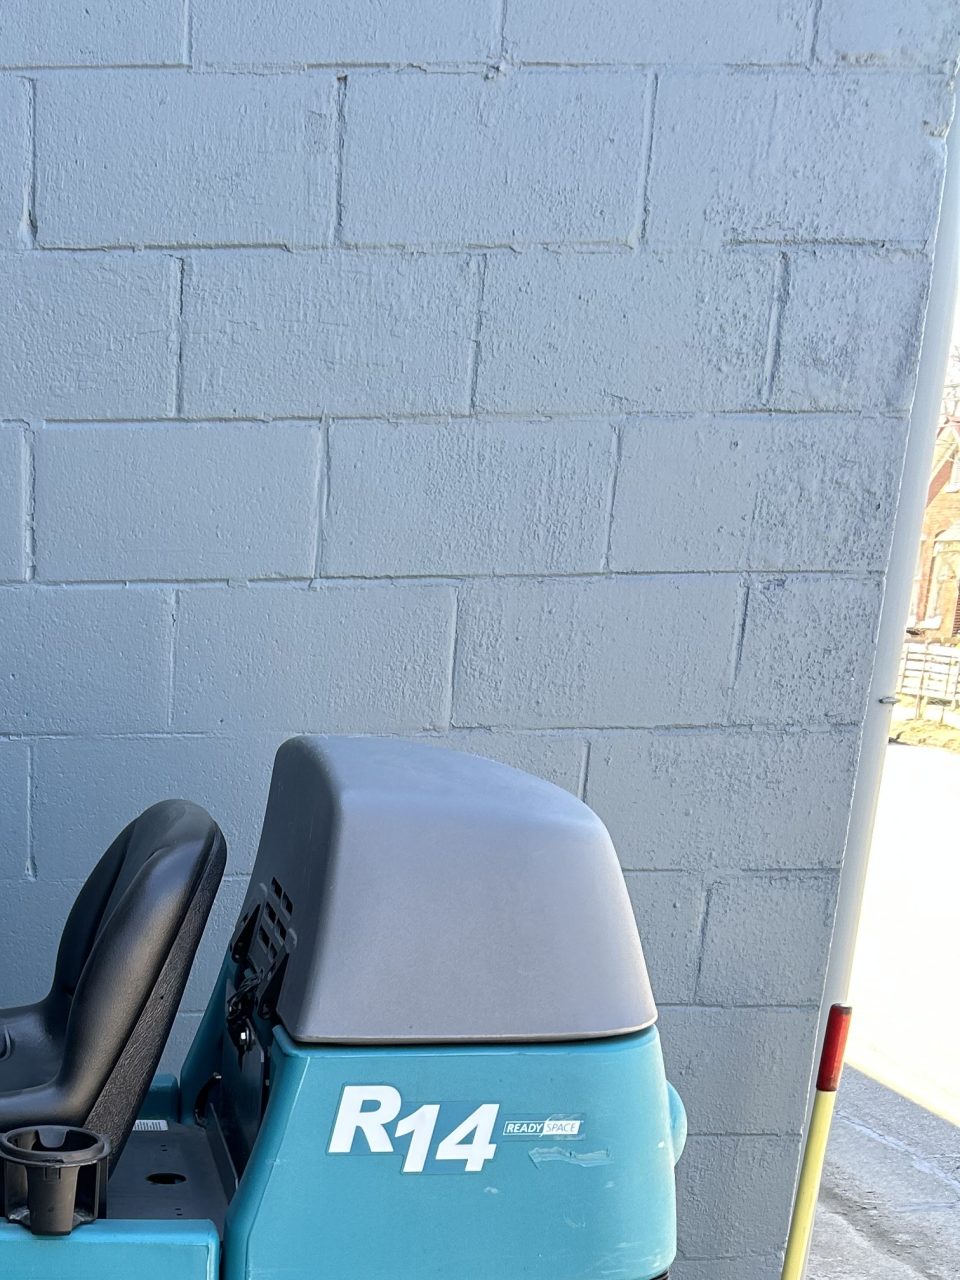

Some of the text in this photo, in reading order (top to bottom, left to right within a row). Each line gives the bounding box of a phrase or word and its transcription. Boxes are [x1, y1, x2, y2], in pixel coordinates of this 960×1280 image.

[328, 1085, 500, 1173] R14
[506, 1122, 577, 1133] READY SPACE
